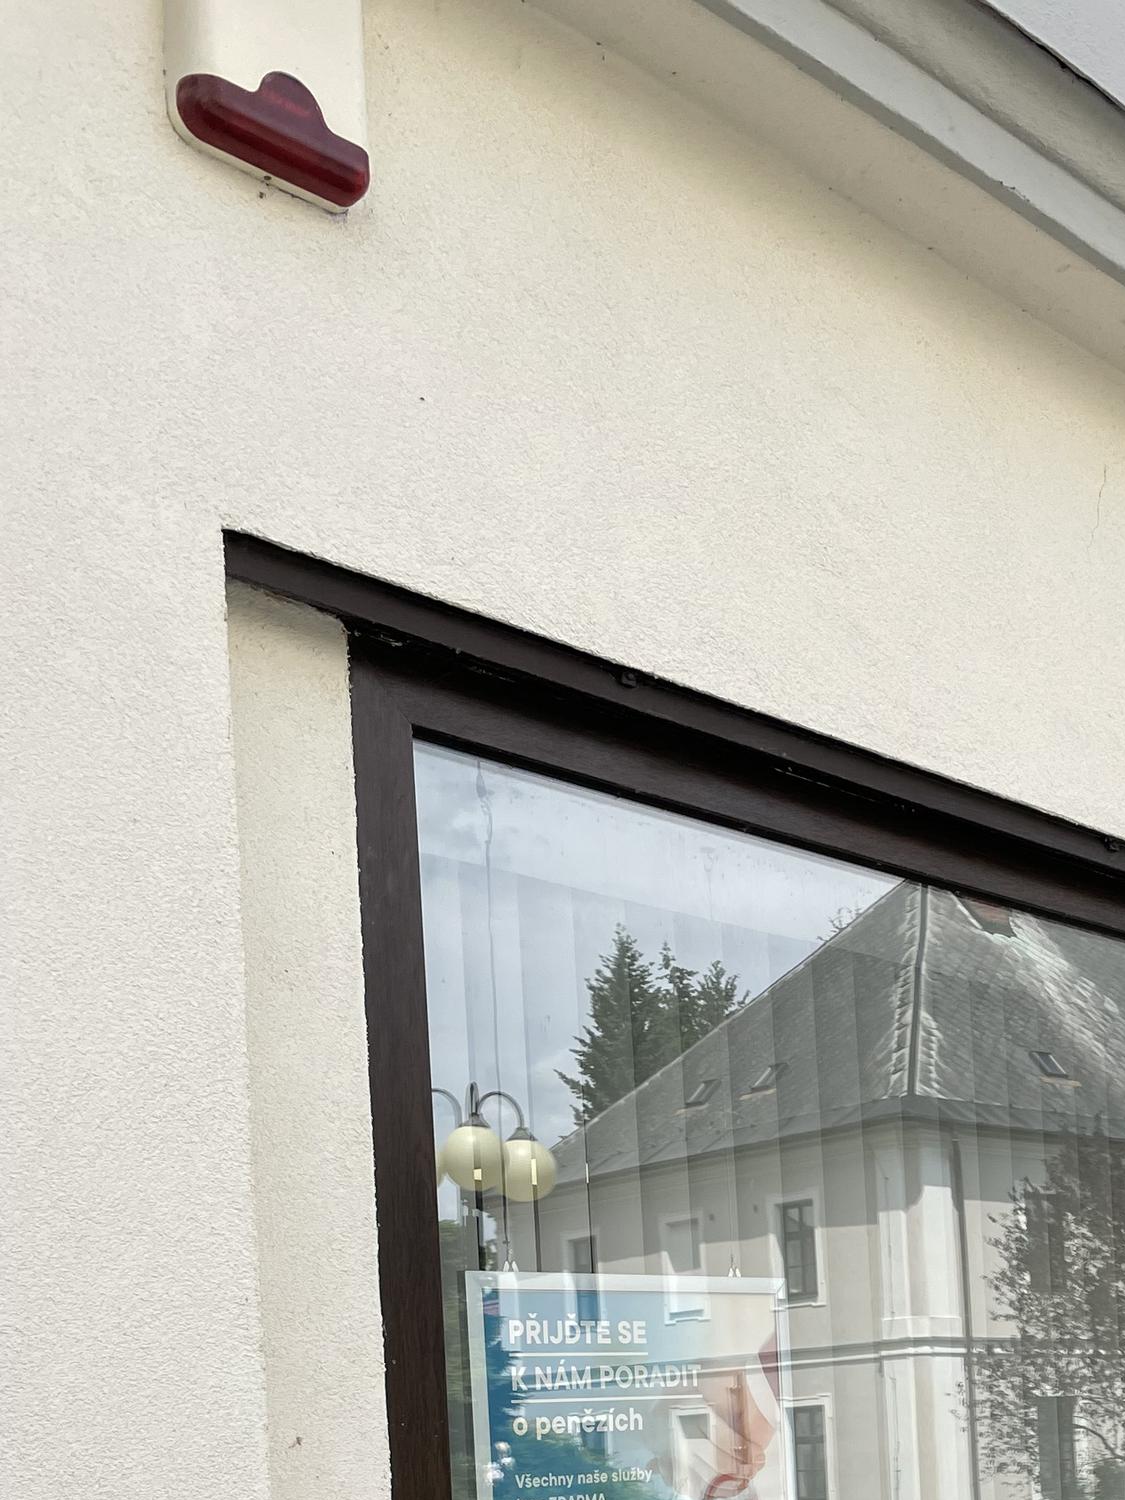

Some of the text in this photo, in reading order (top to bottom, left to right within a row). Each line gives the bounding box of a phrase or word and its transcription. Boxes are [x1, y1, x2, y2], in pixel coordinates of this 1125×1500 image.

[508, 1313, 648, 1346] PŘIJĎTE SE
[512, 1359, 702, 1391] K NÁM PORADIT
[512, 1408, 643, 1440] o penězích
[515, 1468, 653, 1489] Všechny naše služby
